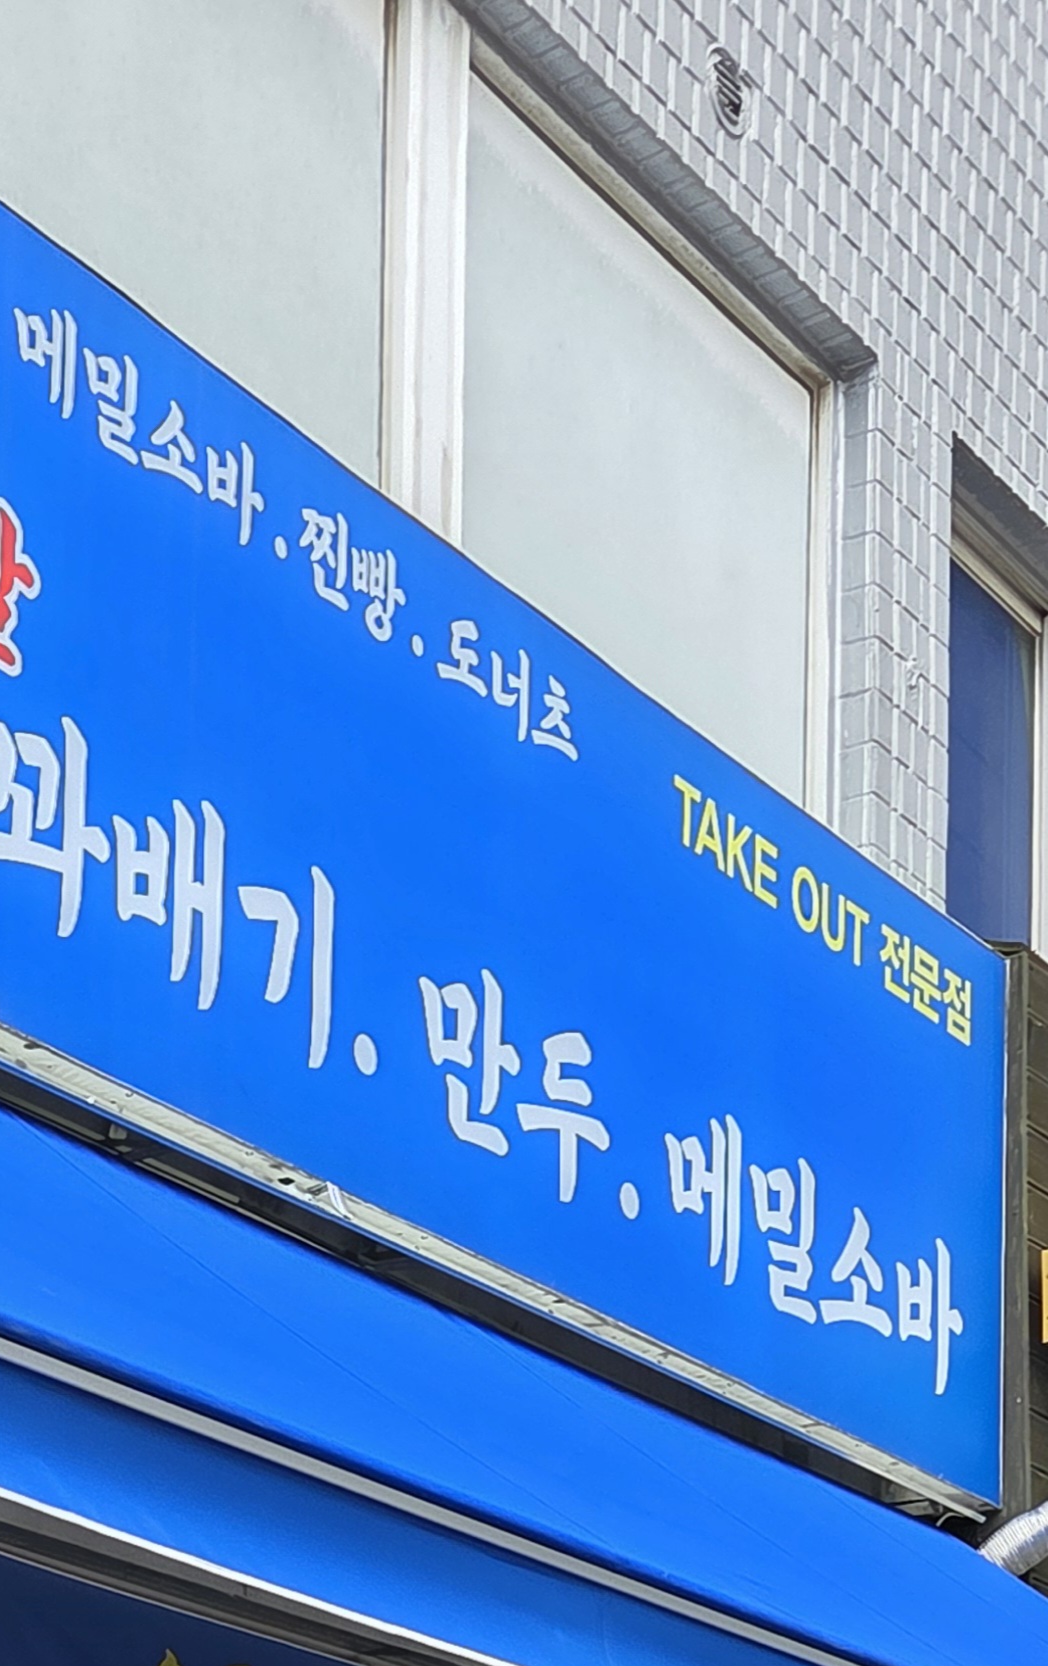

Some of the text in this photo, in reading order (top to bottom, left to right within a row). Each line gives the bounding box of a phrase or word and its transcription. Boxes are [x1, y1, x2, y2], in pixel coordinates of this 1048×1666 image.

[437, 620, 578, 761] 도너츠
[674, 774, 971, 1047] TAKE OUT 전문점
[664, 1114, 963, 1396] 메밀소바
